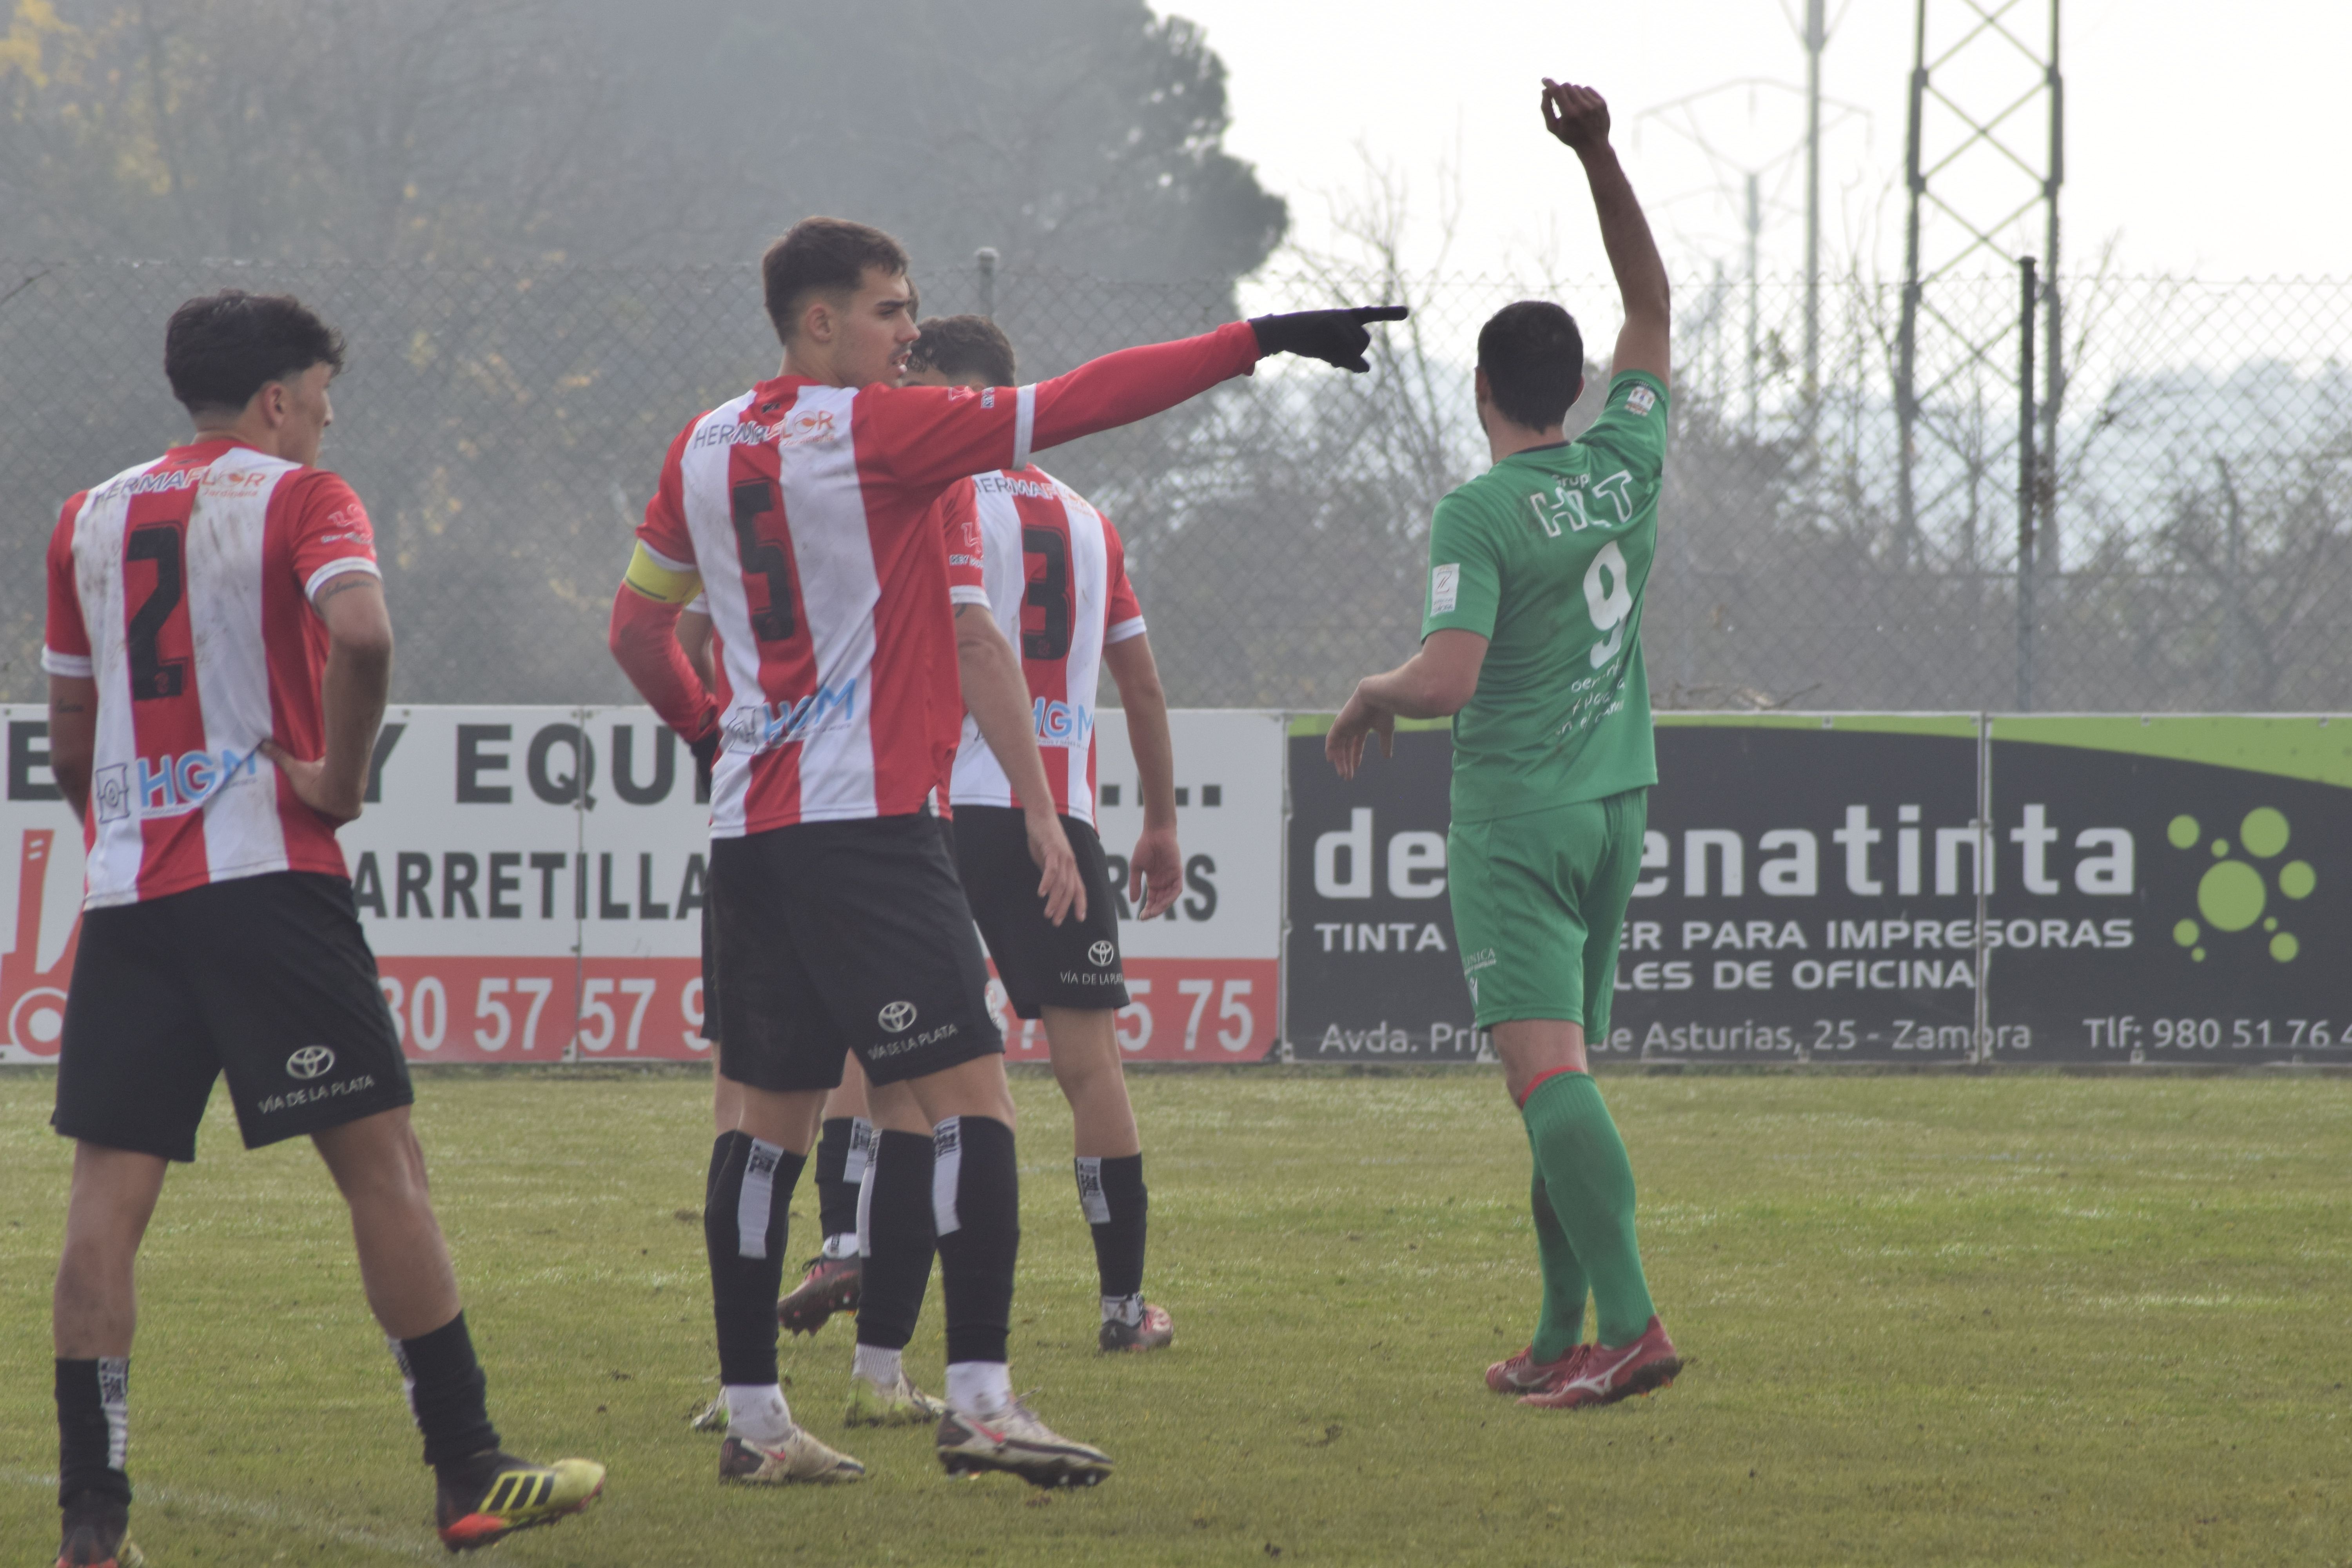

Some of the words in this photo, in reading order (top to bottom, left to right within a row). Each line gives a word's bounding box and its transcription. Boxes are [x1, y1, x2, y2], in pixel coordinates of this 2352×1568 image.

[734, 478, 795, 641] 5
[1023, 526, 1071, 660] 3
[127, 520, 187, 701] 2
[1583, 540, 1632, 669] 9
[353, 851, 704, 920] ARRETILLA
[1314, 806, 2134, 899] deenatinta
[1314, 923, 1447, 952] TINTA
[1683, 920, 1808, 950] PARA
[1826, 919, 2134, 949] IMPRESORAS
[1060, 970, 1078, 984] VÍA
[1082, 973, 1096, 985] DE
[1100, 973, 1109, 985] LA
[1613, 961, 1693, 990] LES
[1713, 960, 1774, 990] DE
[1792, 959, 1976, 989] OFICINA
[474, 977, 552, 1052] 57
[578, 978, 657, 1052] 57
[1178, 979, 1253, 1052] 75
[1319, 1021, 1418, 1053] Avda.
[1813, 1020, 1857, 1050] 25
[2082, 1016, 2142, 1049] Tlf:
[2153, 1018, 2221, 1049] 980
[2232, 1019, 2272, 1049] 51
[2286, 1020, 2330, 1049] 76
[309, 1084, 329, 1102] LA
[331, 1074, 375, 1096] PLATA
